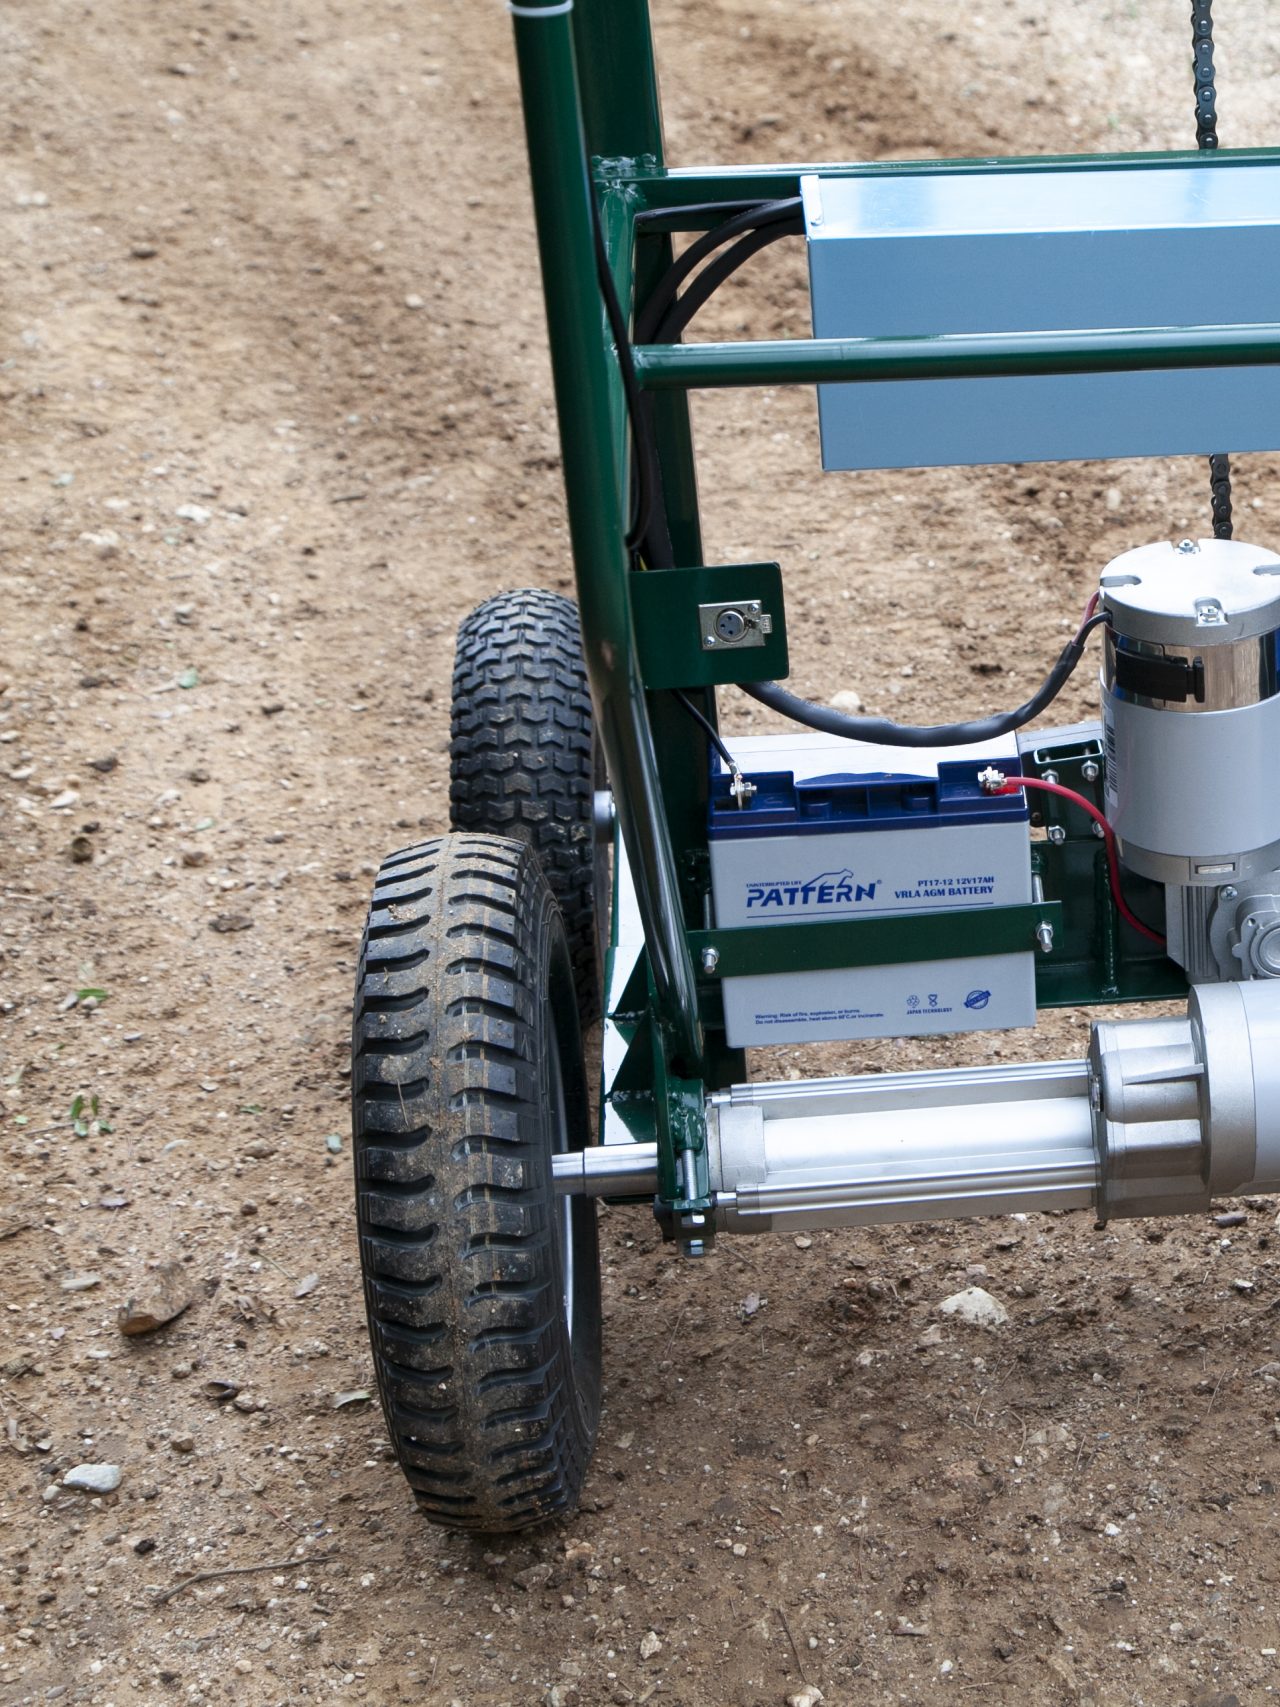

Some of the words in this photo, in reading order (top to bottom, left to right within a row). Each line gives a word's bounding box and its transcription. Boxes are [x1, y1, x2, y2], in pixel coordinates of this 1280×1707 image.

[918, 879, 953, 887] PT17-12
[956, 876, 995, 885] 12V17AH
[746, 883, 876, 908] PATTERN
[894, 890, 921, 899] VRLA
[923, 888, 946, 897] AGM
[948, 886, 994, 896] BATTERY
